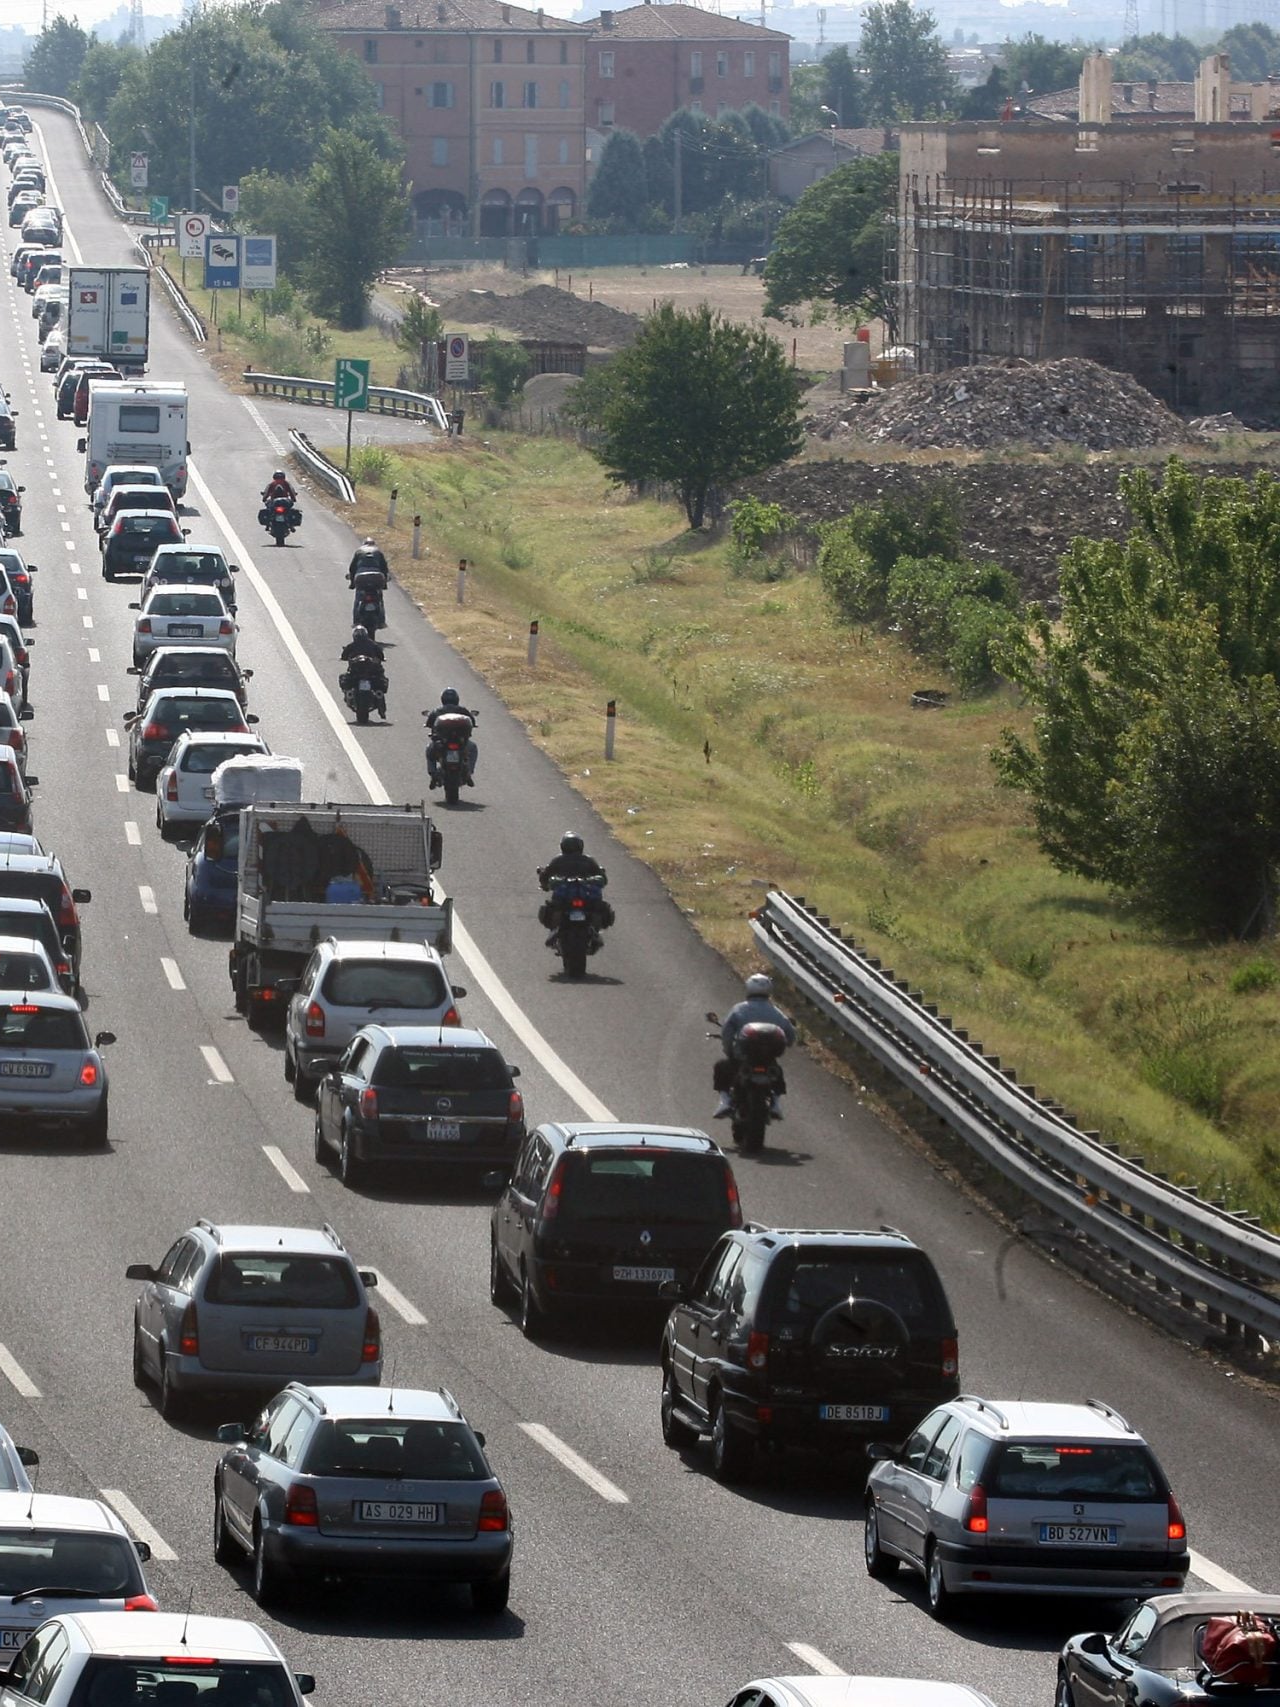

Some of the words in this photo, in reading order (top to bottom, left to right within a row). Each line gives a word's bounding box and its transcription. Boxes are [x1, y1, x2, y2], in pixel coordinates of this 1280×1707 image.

[255, 1338, 269, 1349] CF
[827, 1344, 899, 1357] Safari
[827, 1407, 841, 1418] DE
[846, 1407, 882, 1419] 851BJ
[366, 1505, 381, 1517] AS
[389, 1505, 413, 1519] 029
[418, 1507, 434, 1520] HH
[1048, 1526, 1064, 1540] BD
[1069, 1527, 1109, 1541] 527VN
[3, 1632, 19, 1646] CK
